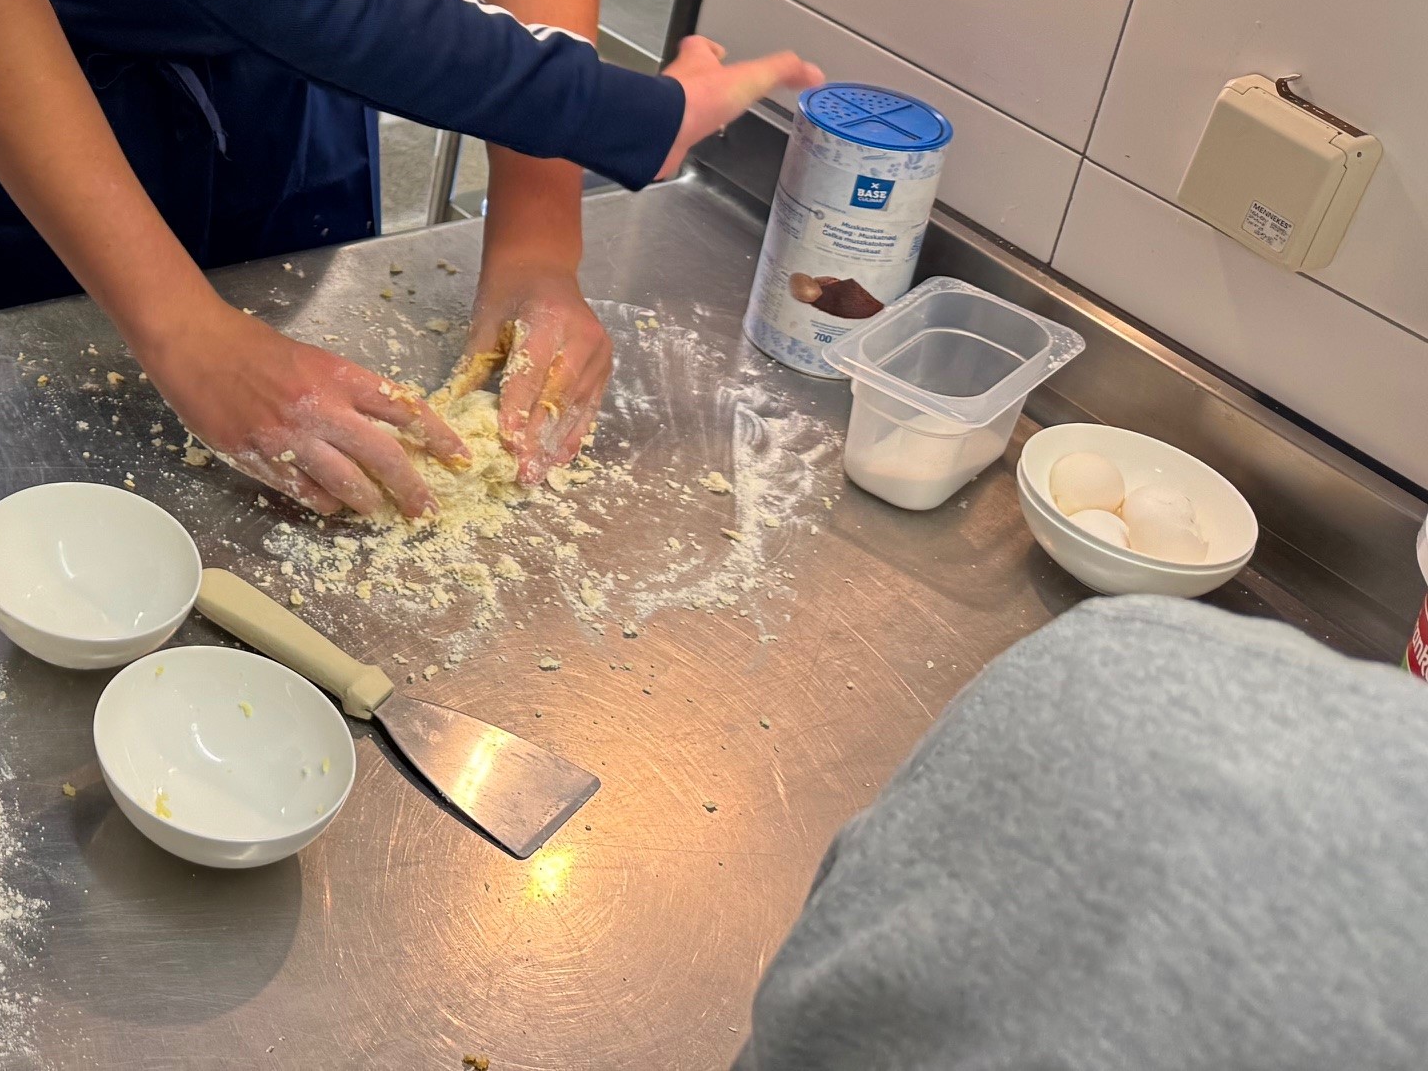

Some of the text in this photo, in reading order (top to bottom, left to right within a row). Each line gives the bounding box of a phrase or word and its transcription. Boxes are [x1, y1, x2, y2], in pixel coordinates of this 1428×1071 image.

[857, 188, 888, 199] BASE
[823, 223, 853, 237] Nutmeg
[813, 331, 832, 344] 700
